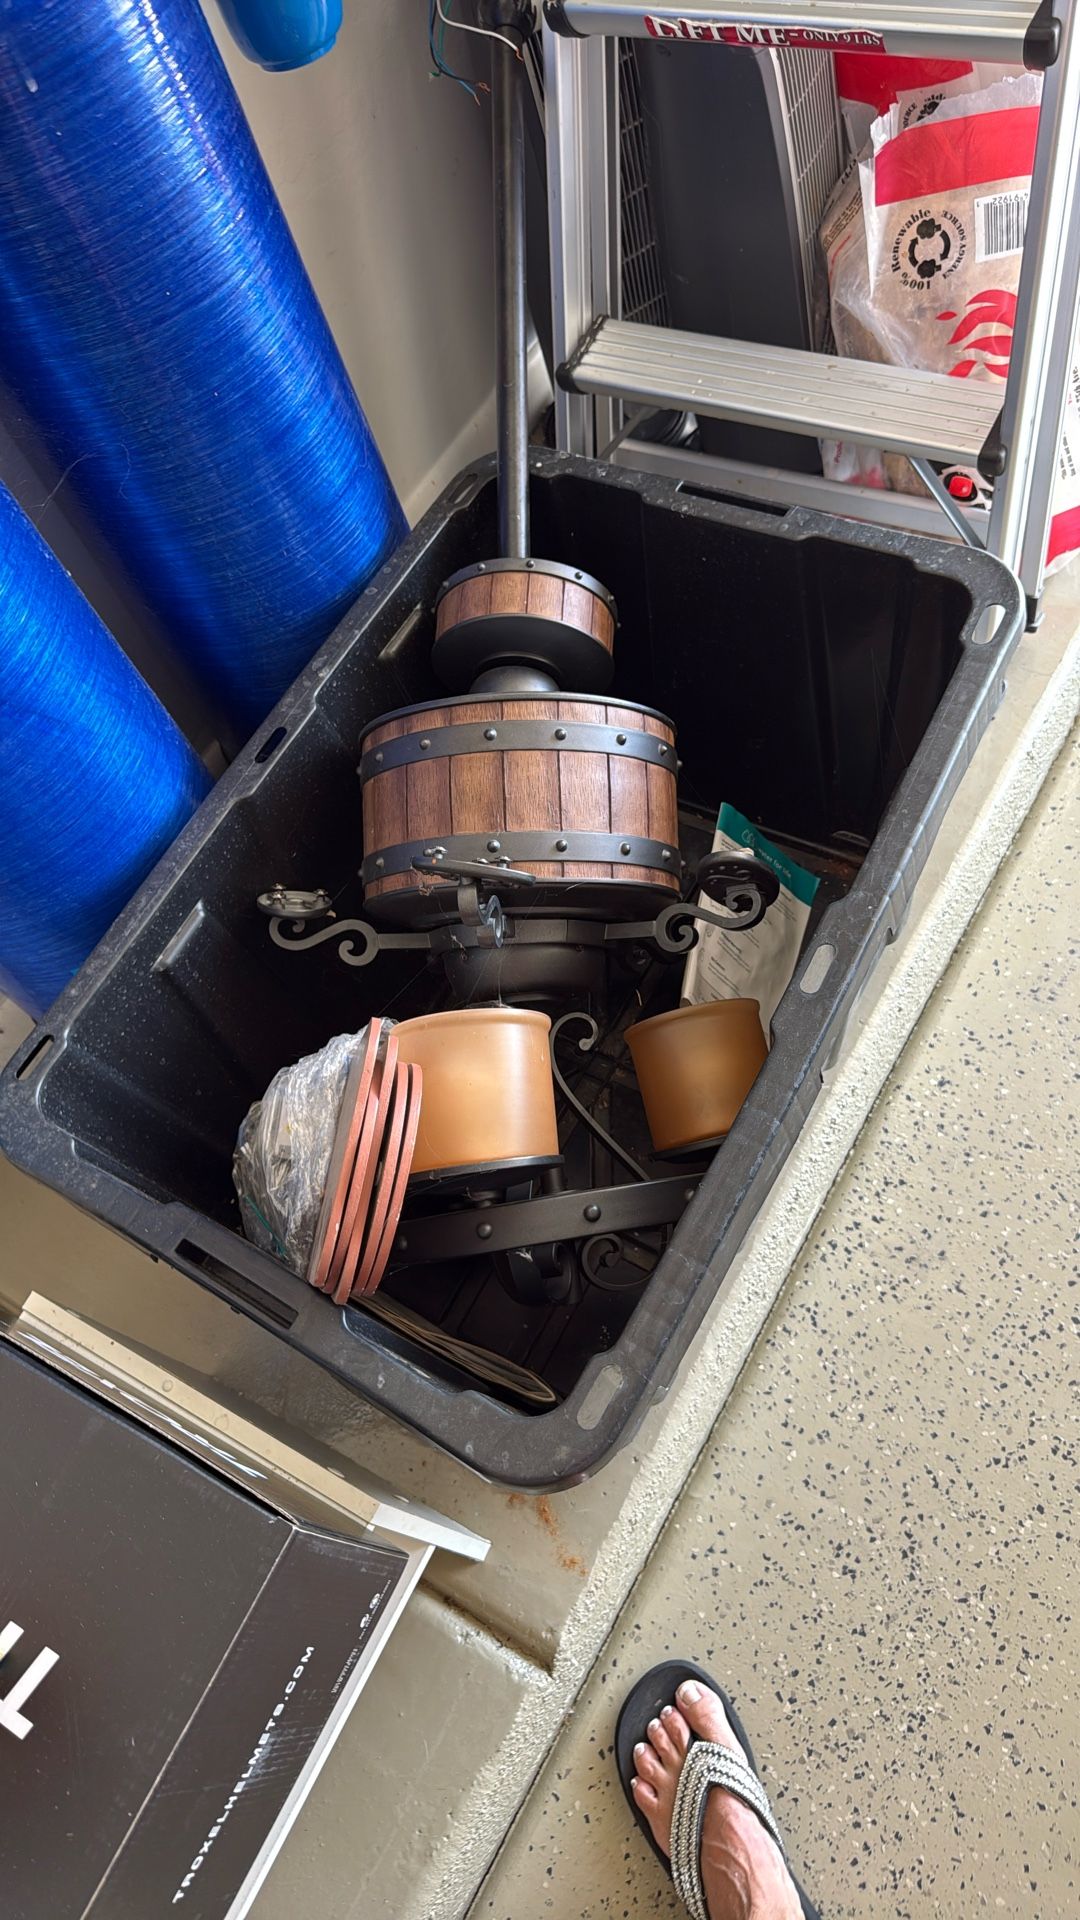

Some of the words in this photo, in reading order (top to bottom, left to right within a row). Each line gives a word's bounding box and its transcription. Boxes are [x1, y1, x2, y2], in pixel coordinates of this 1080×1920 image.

[803, 31, 839, 43] ONLY
[843, 33, 850, 43] 9
[855, 33, 880, 45] LBS
[891, 209, 931, 272] Renewable
[941, 210, 966, 242] SOURCE
[942, 243, 966, 279] ENERGY
[900, 271, 931, 290] 100%
[172, 1646, 314, 1904] TROXELHELMETS.COM
